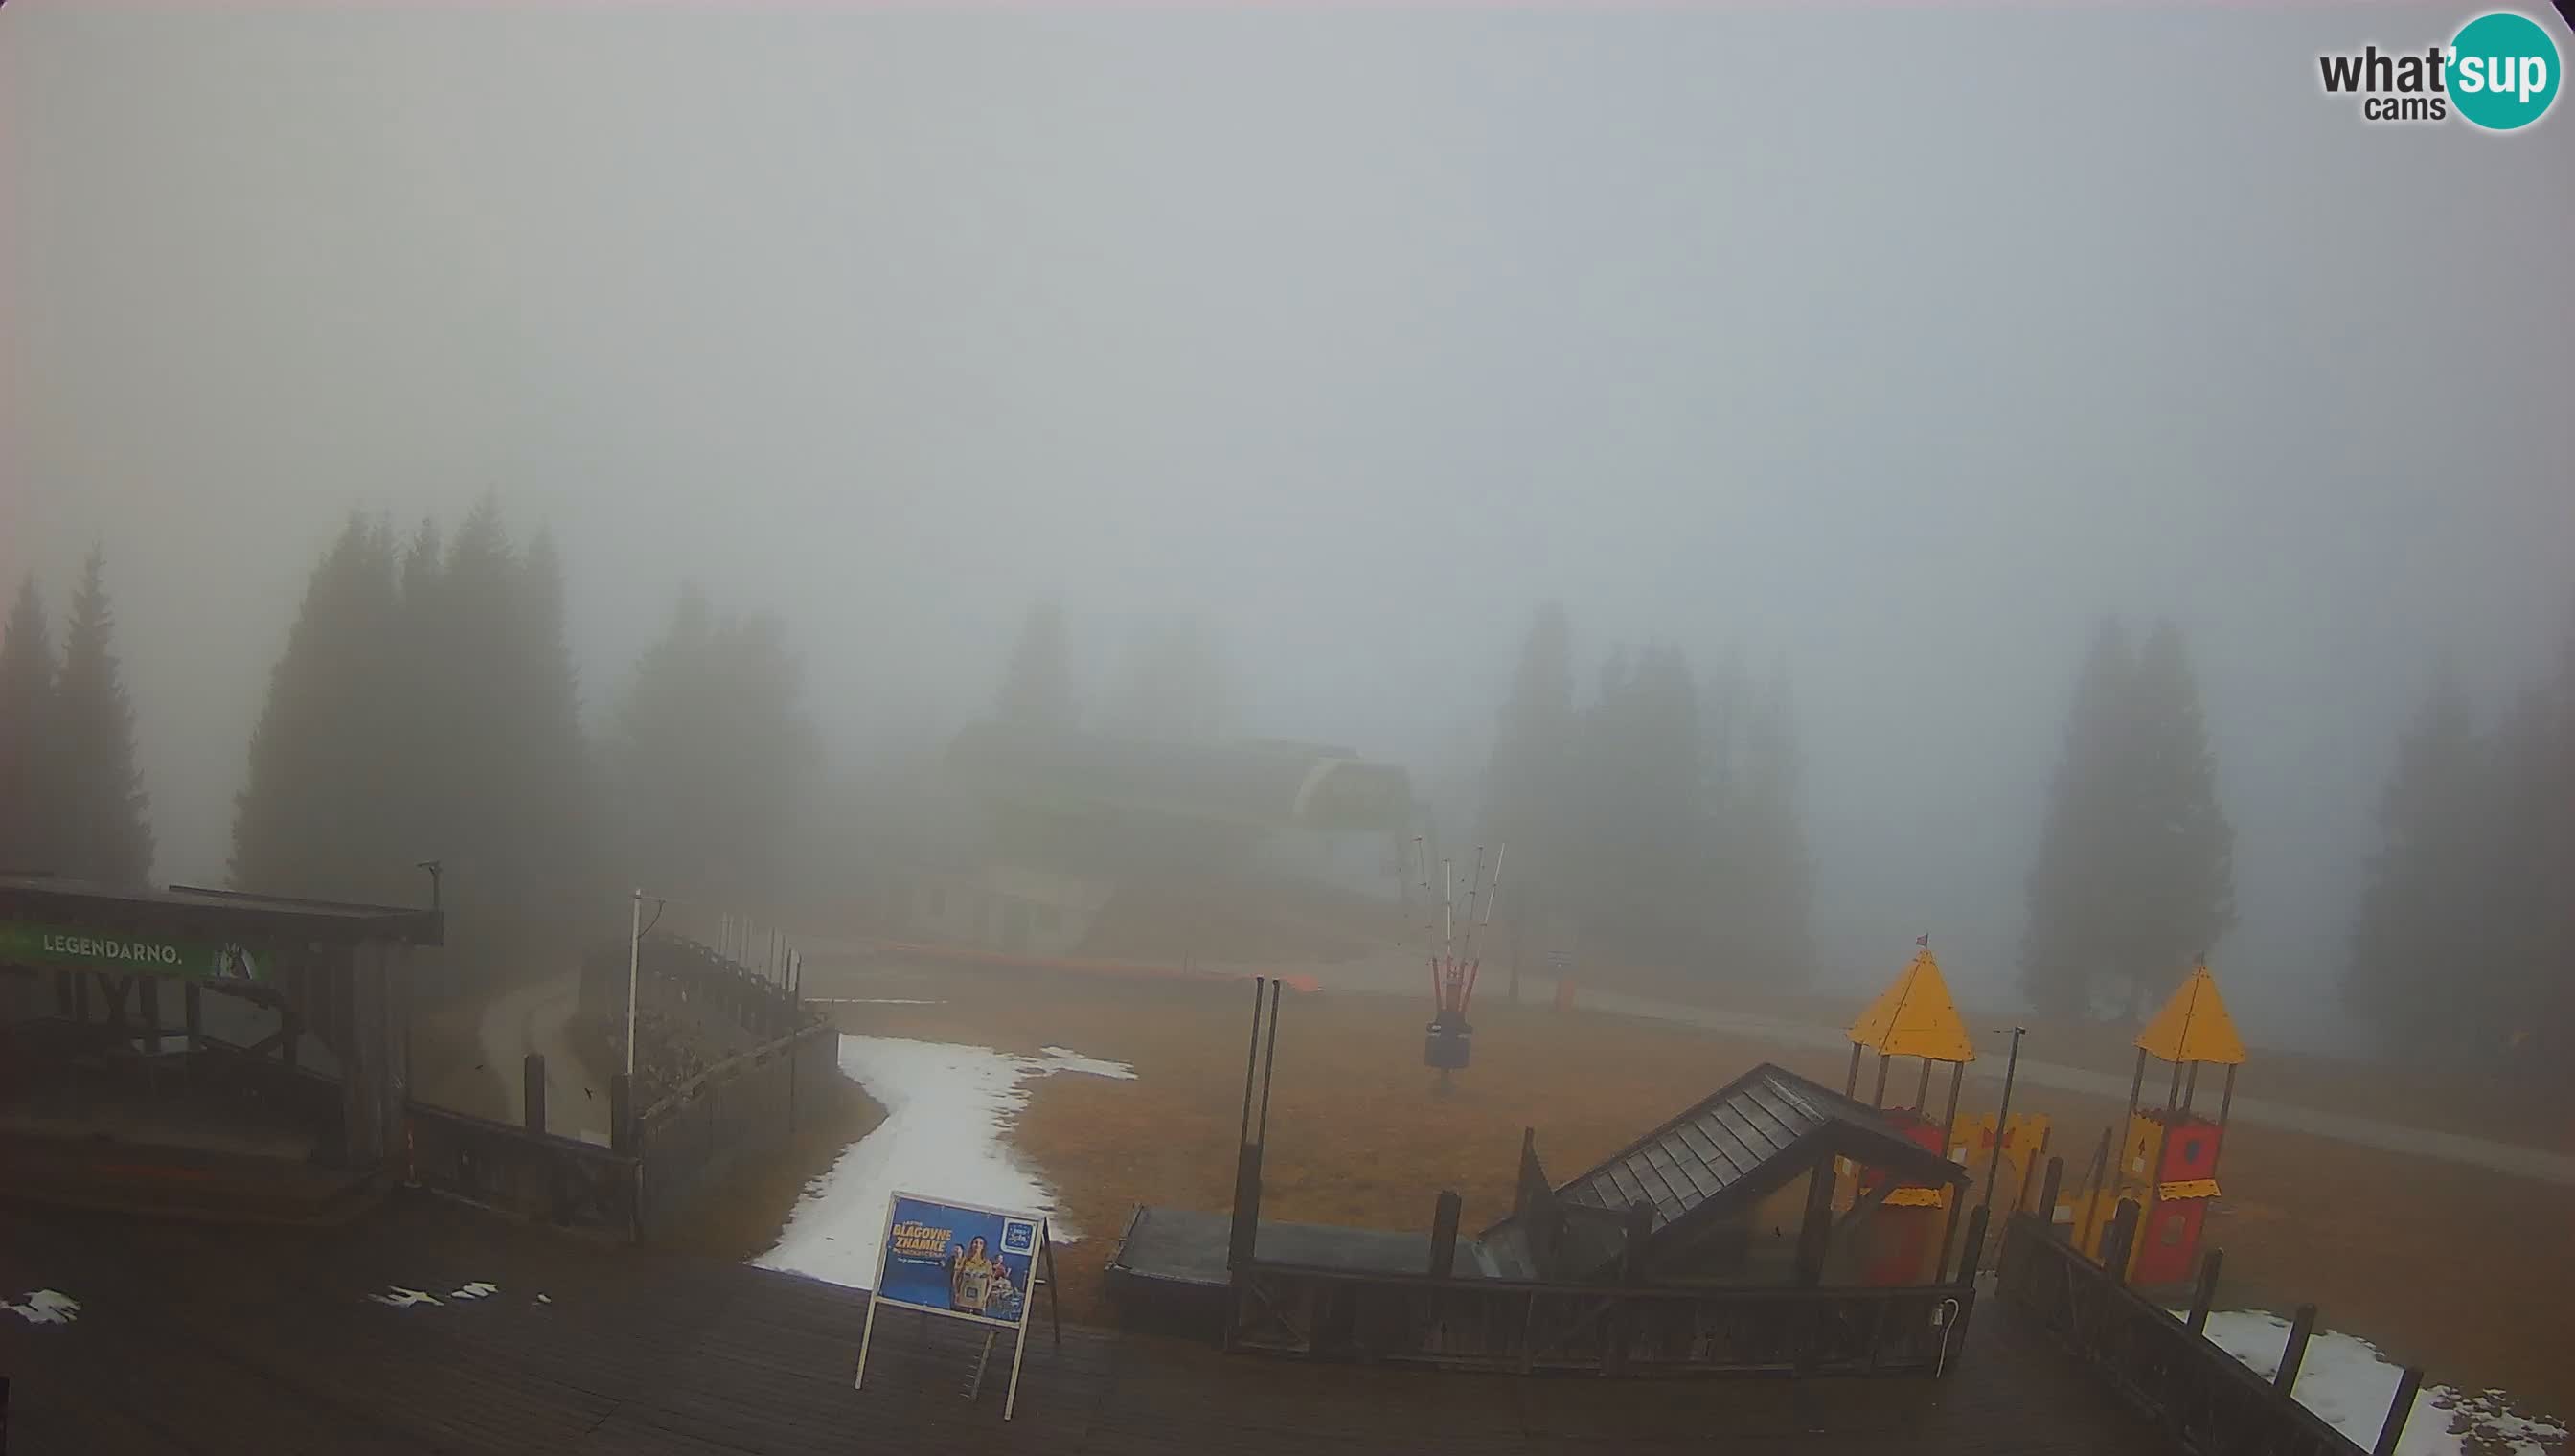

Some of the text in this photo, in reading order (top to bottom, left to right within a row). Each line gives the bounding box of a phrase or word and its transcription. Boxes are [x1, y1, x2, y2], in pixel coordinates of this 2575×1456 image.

[44, 935, 182, 965] LEGENDARNO.
[893, 1224, 952, 1240] BLAGOVNE
[896, 1237, 946, 1252] ZNAMKE
